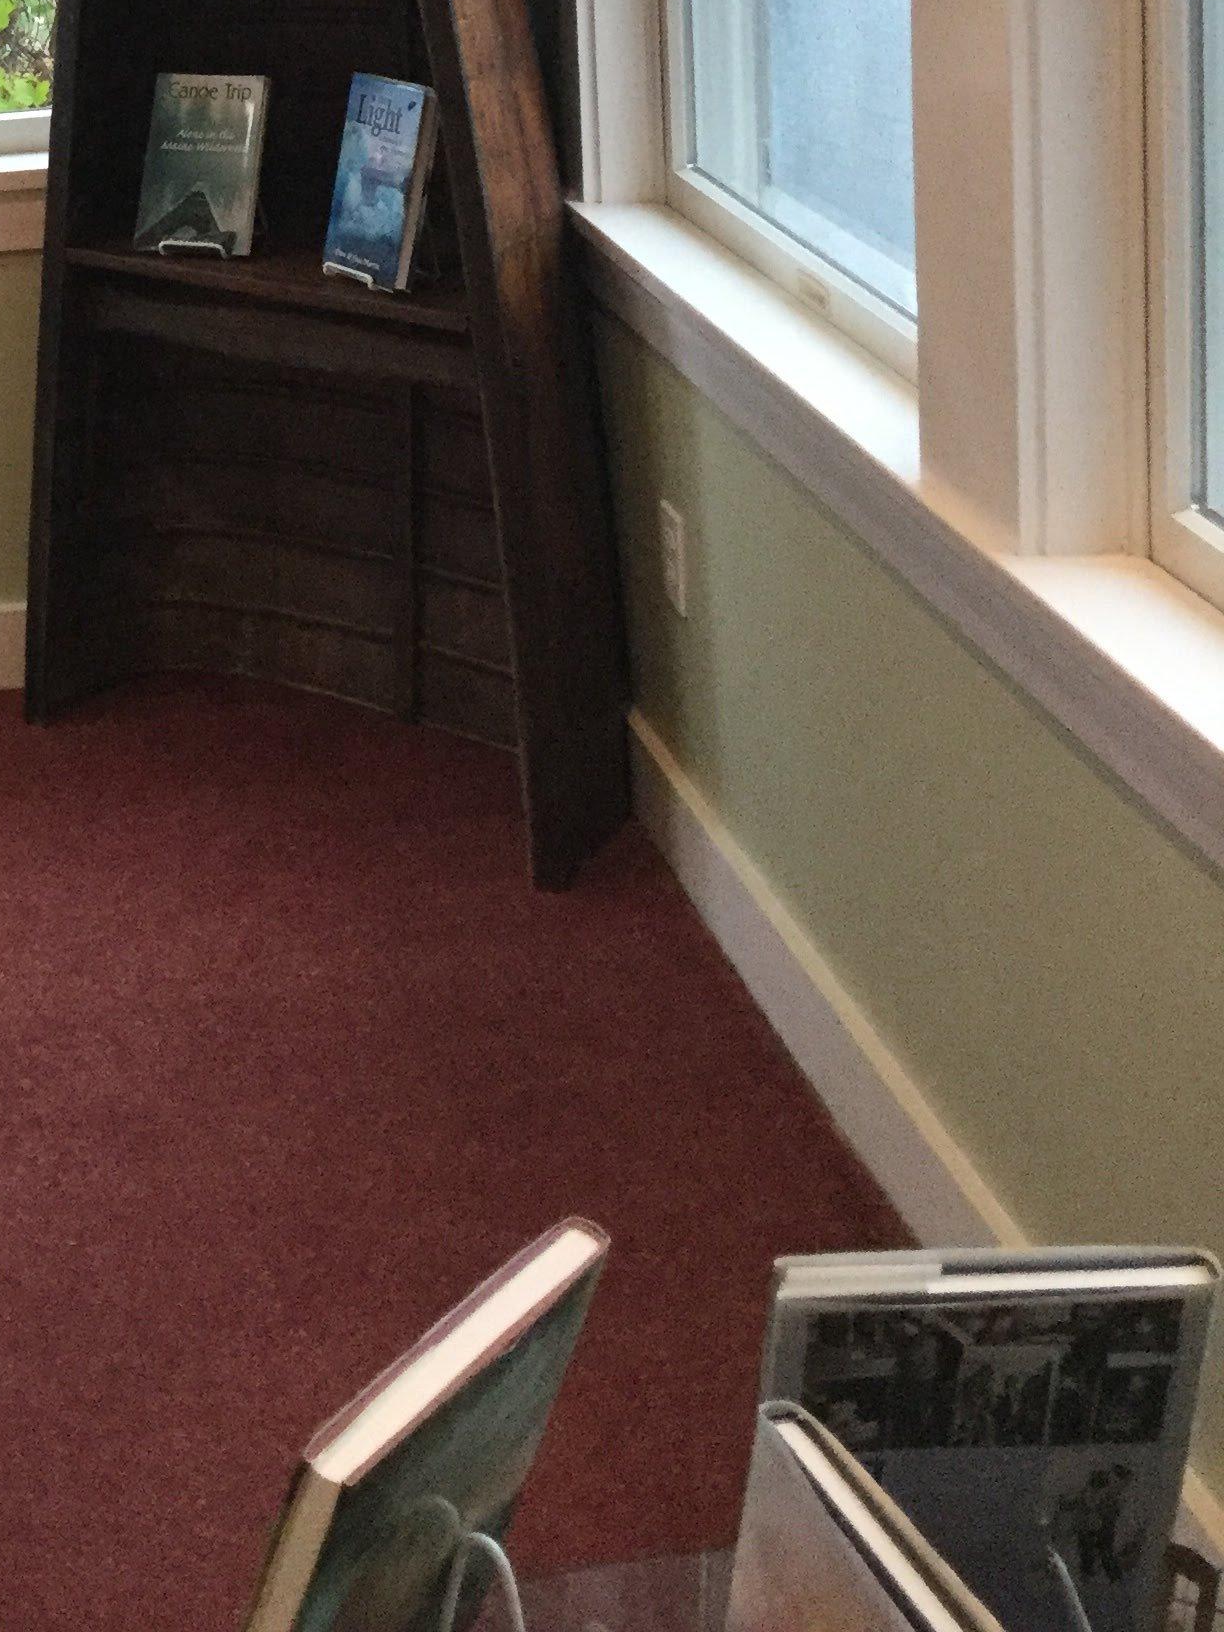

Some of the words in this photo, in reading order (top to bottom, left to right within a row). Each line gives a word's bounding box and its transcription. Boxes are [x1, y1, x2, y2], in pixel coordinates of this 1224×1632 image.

[168, 82, 219, 100] Canoe
[225, 82, 252, 103] Trip
[355, 93, 402, 138] Light
